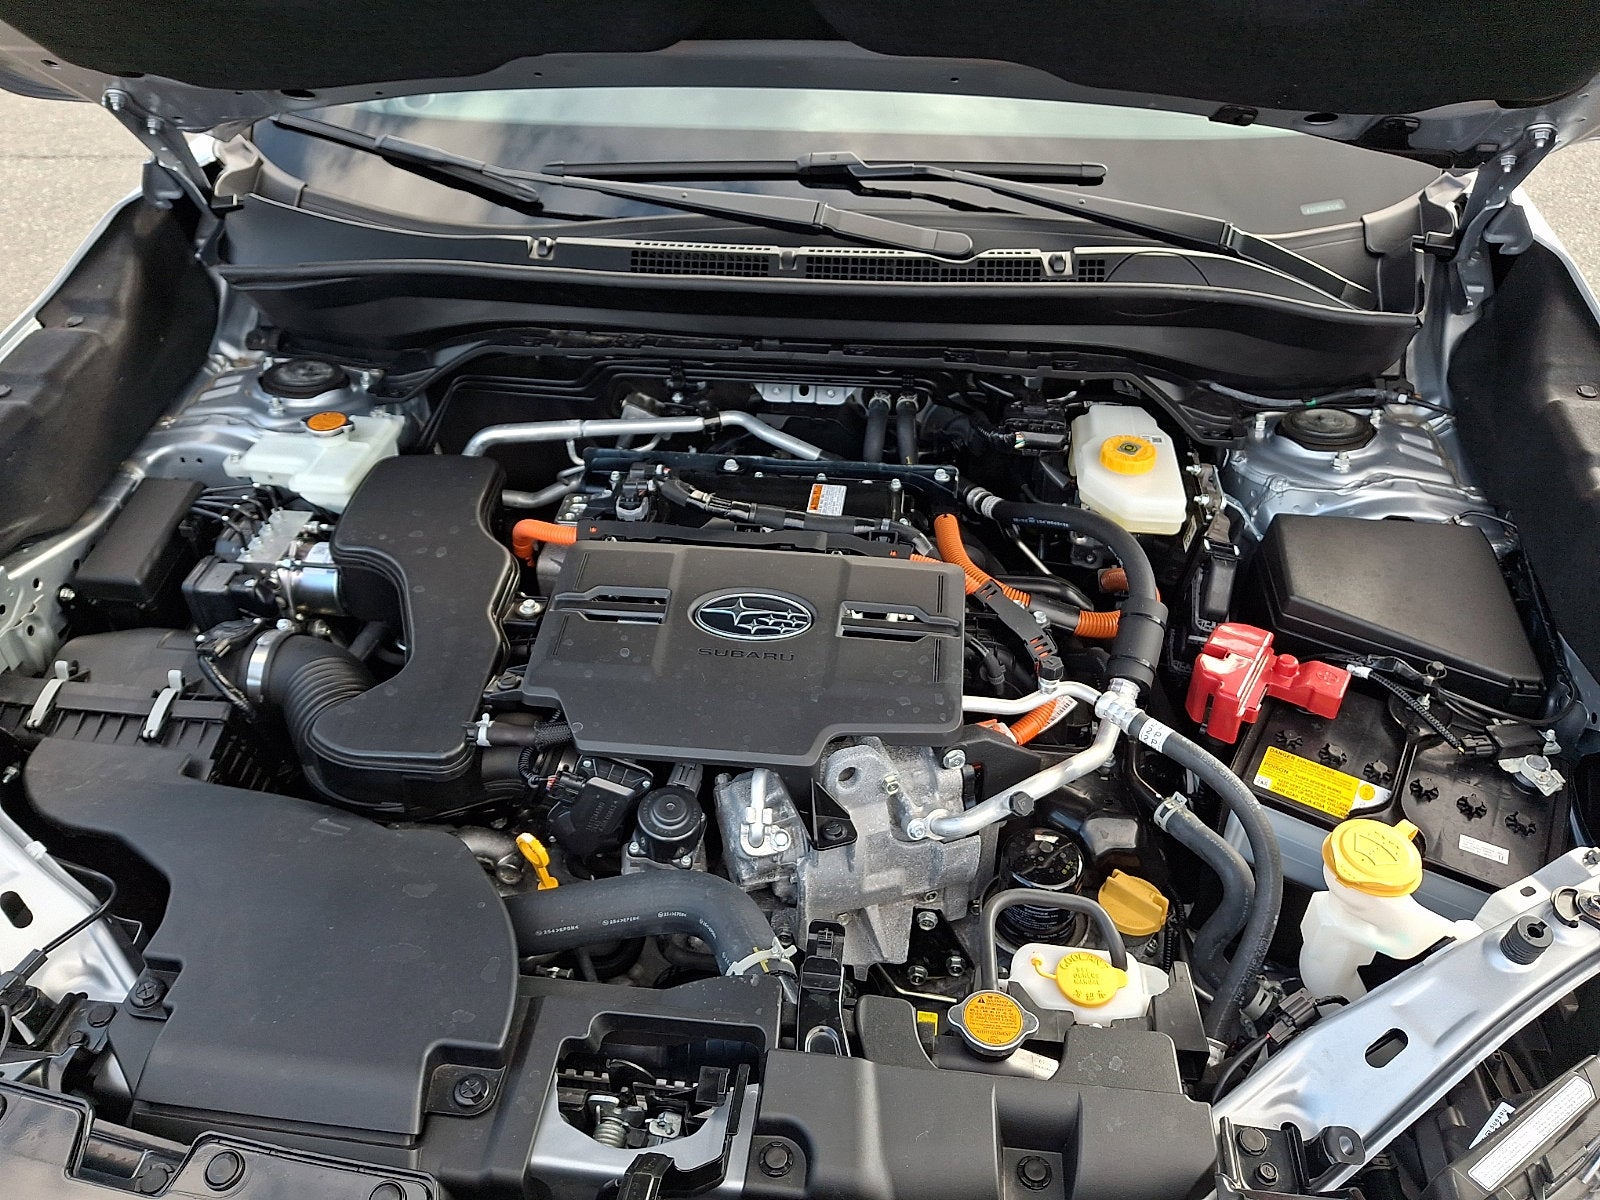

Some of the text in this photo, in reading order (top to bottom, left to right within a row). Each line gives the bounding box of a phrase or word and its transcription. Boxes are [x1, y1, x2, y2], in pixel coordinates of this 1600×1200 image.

[698, 648, 794, 662] SUBARU
[1269, 747, 1295, 760] DANGER
[1263, 761, 1288, 774] POISON
[1059, 953, 1110, 970] COOLANT
[1489, 1108, 1508, 1130] SUBARU
